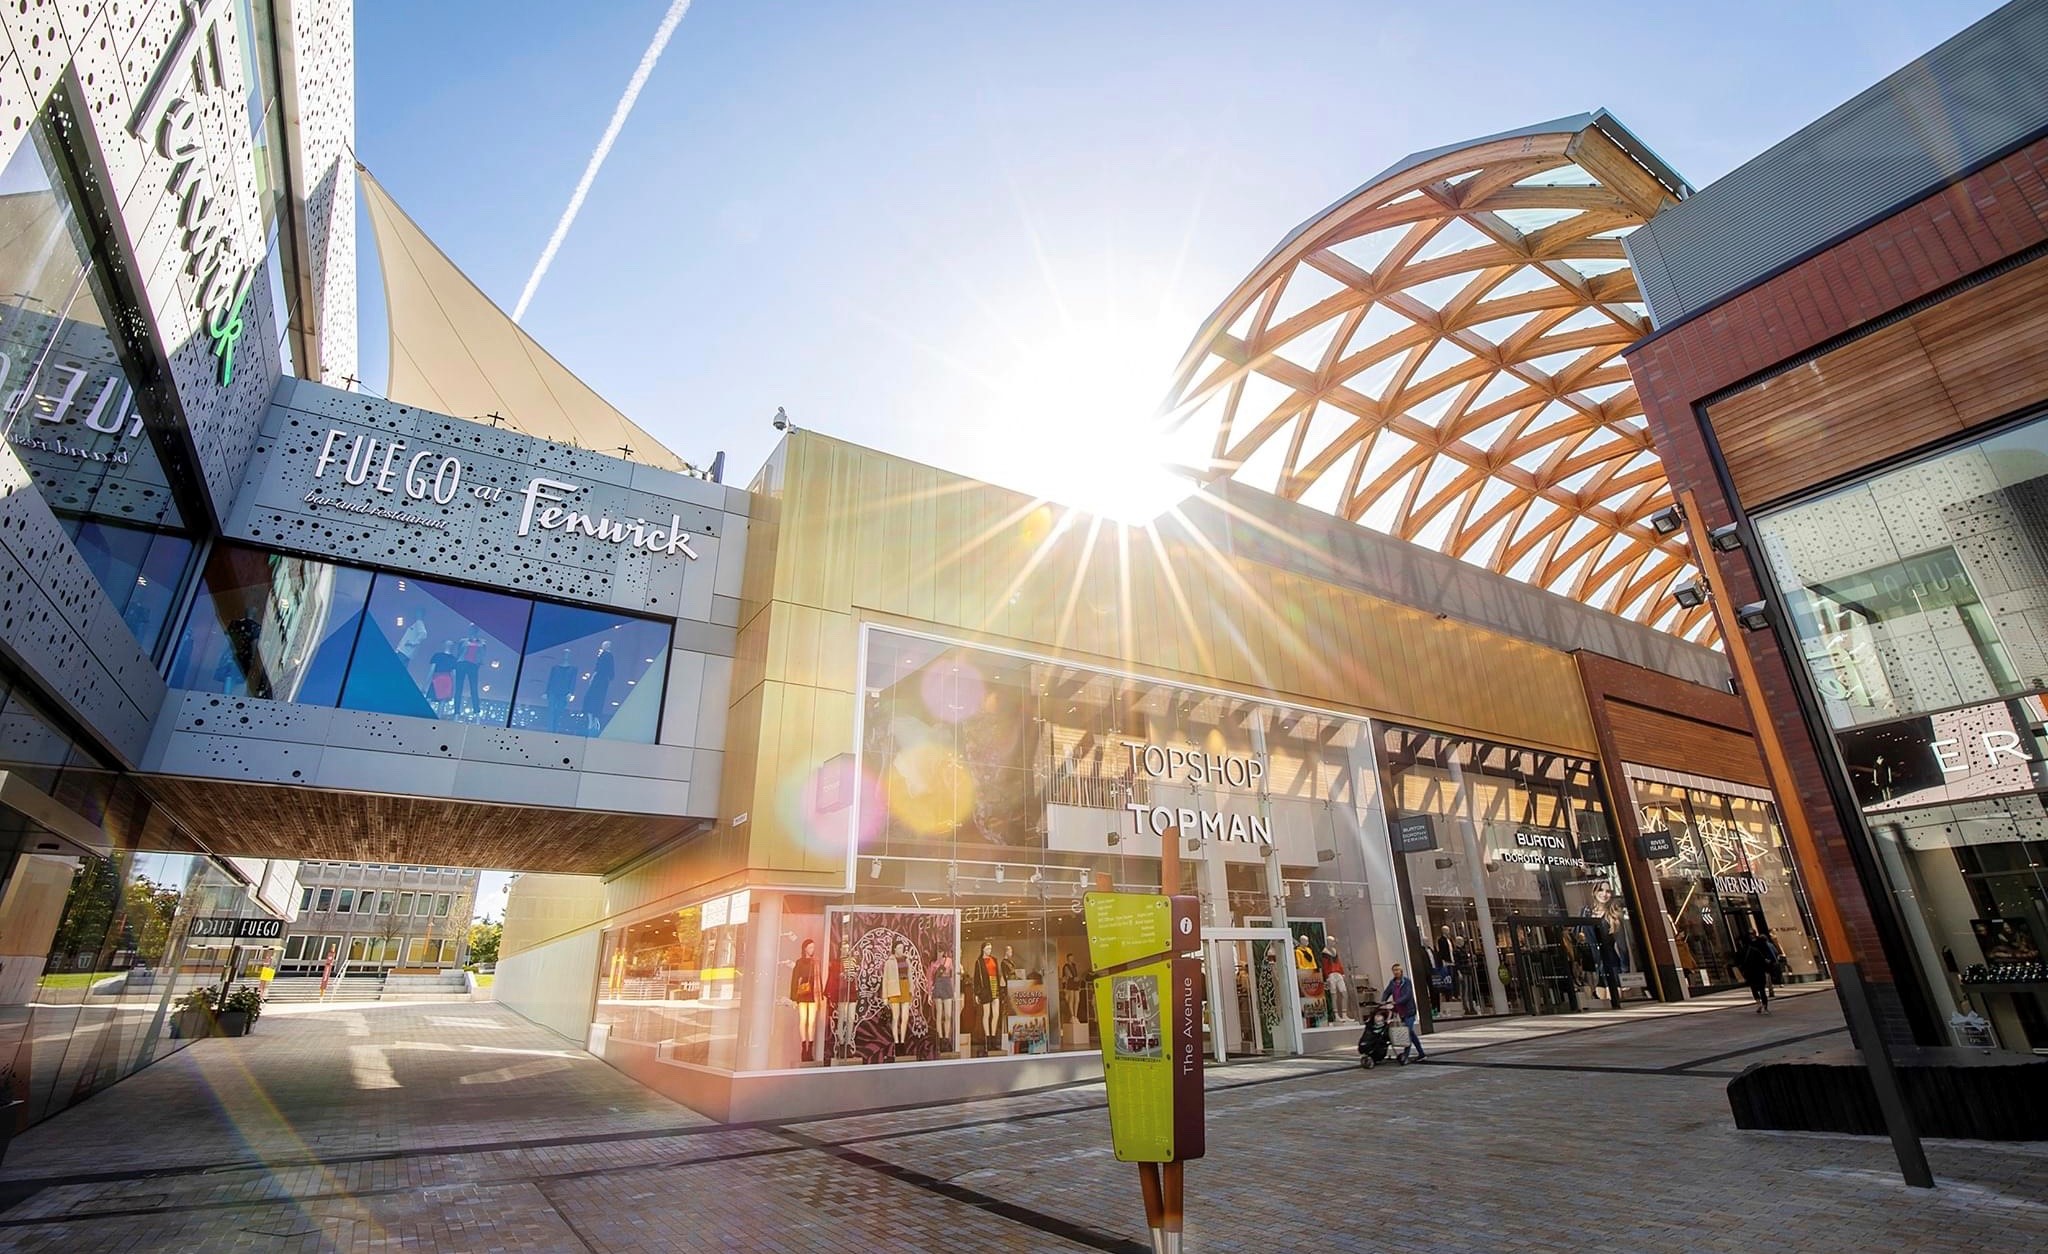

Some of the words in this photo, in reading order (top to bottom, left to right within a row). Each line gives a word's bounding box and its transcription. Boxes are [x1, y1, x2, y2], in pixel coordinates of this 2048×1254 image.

[315, 429, 462, 506] FUEGO
[474, 485, 502, 503] at
[518, 477, 698, 561] Fenwick
[369, 507, 449, 531] restaurant
[1929, 723, 2048, 773] ER
[1120, 741, 1265, 788] TOPSHOP
[1126, 803, 1273, 845] TOPMAN
[1516, 832, 1566, 849] BURTON
[1503, 852, 1546, 865] DOROTHY
[1548, 855, 1585, 868] PERKINS
[1714, 876, 1738, 893] RIVER
[1740, 876, 1768, 894] ISLAND
[240, 920, 280, 936] FUEGO
[1183, 977, 1194, 1038] Avenue
[1183, 1044, 1194, 1076] The
